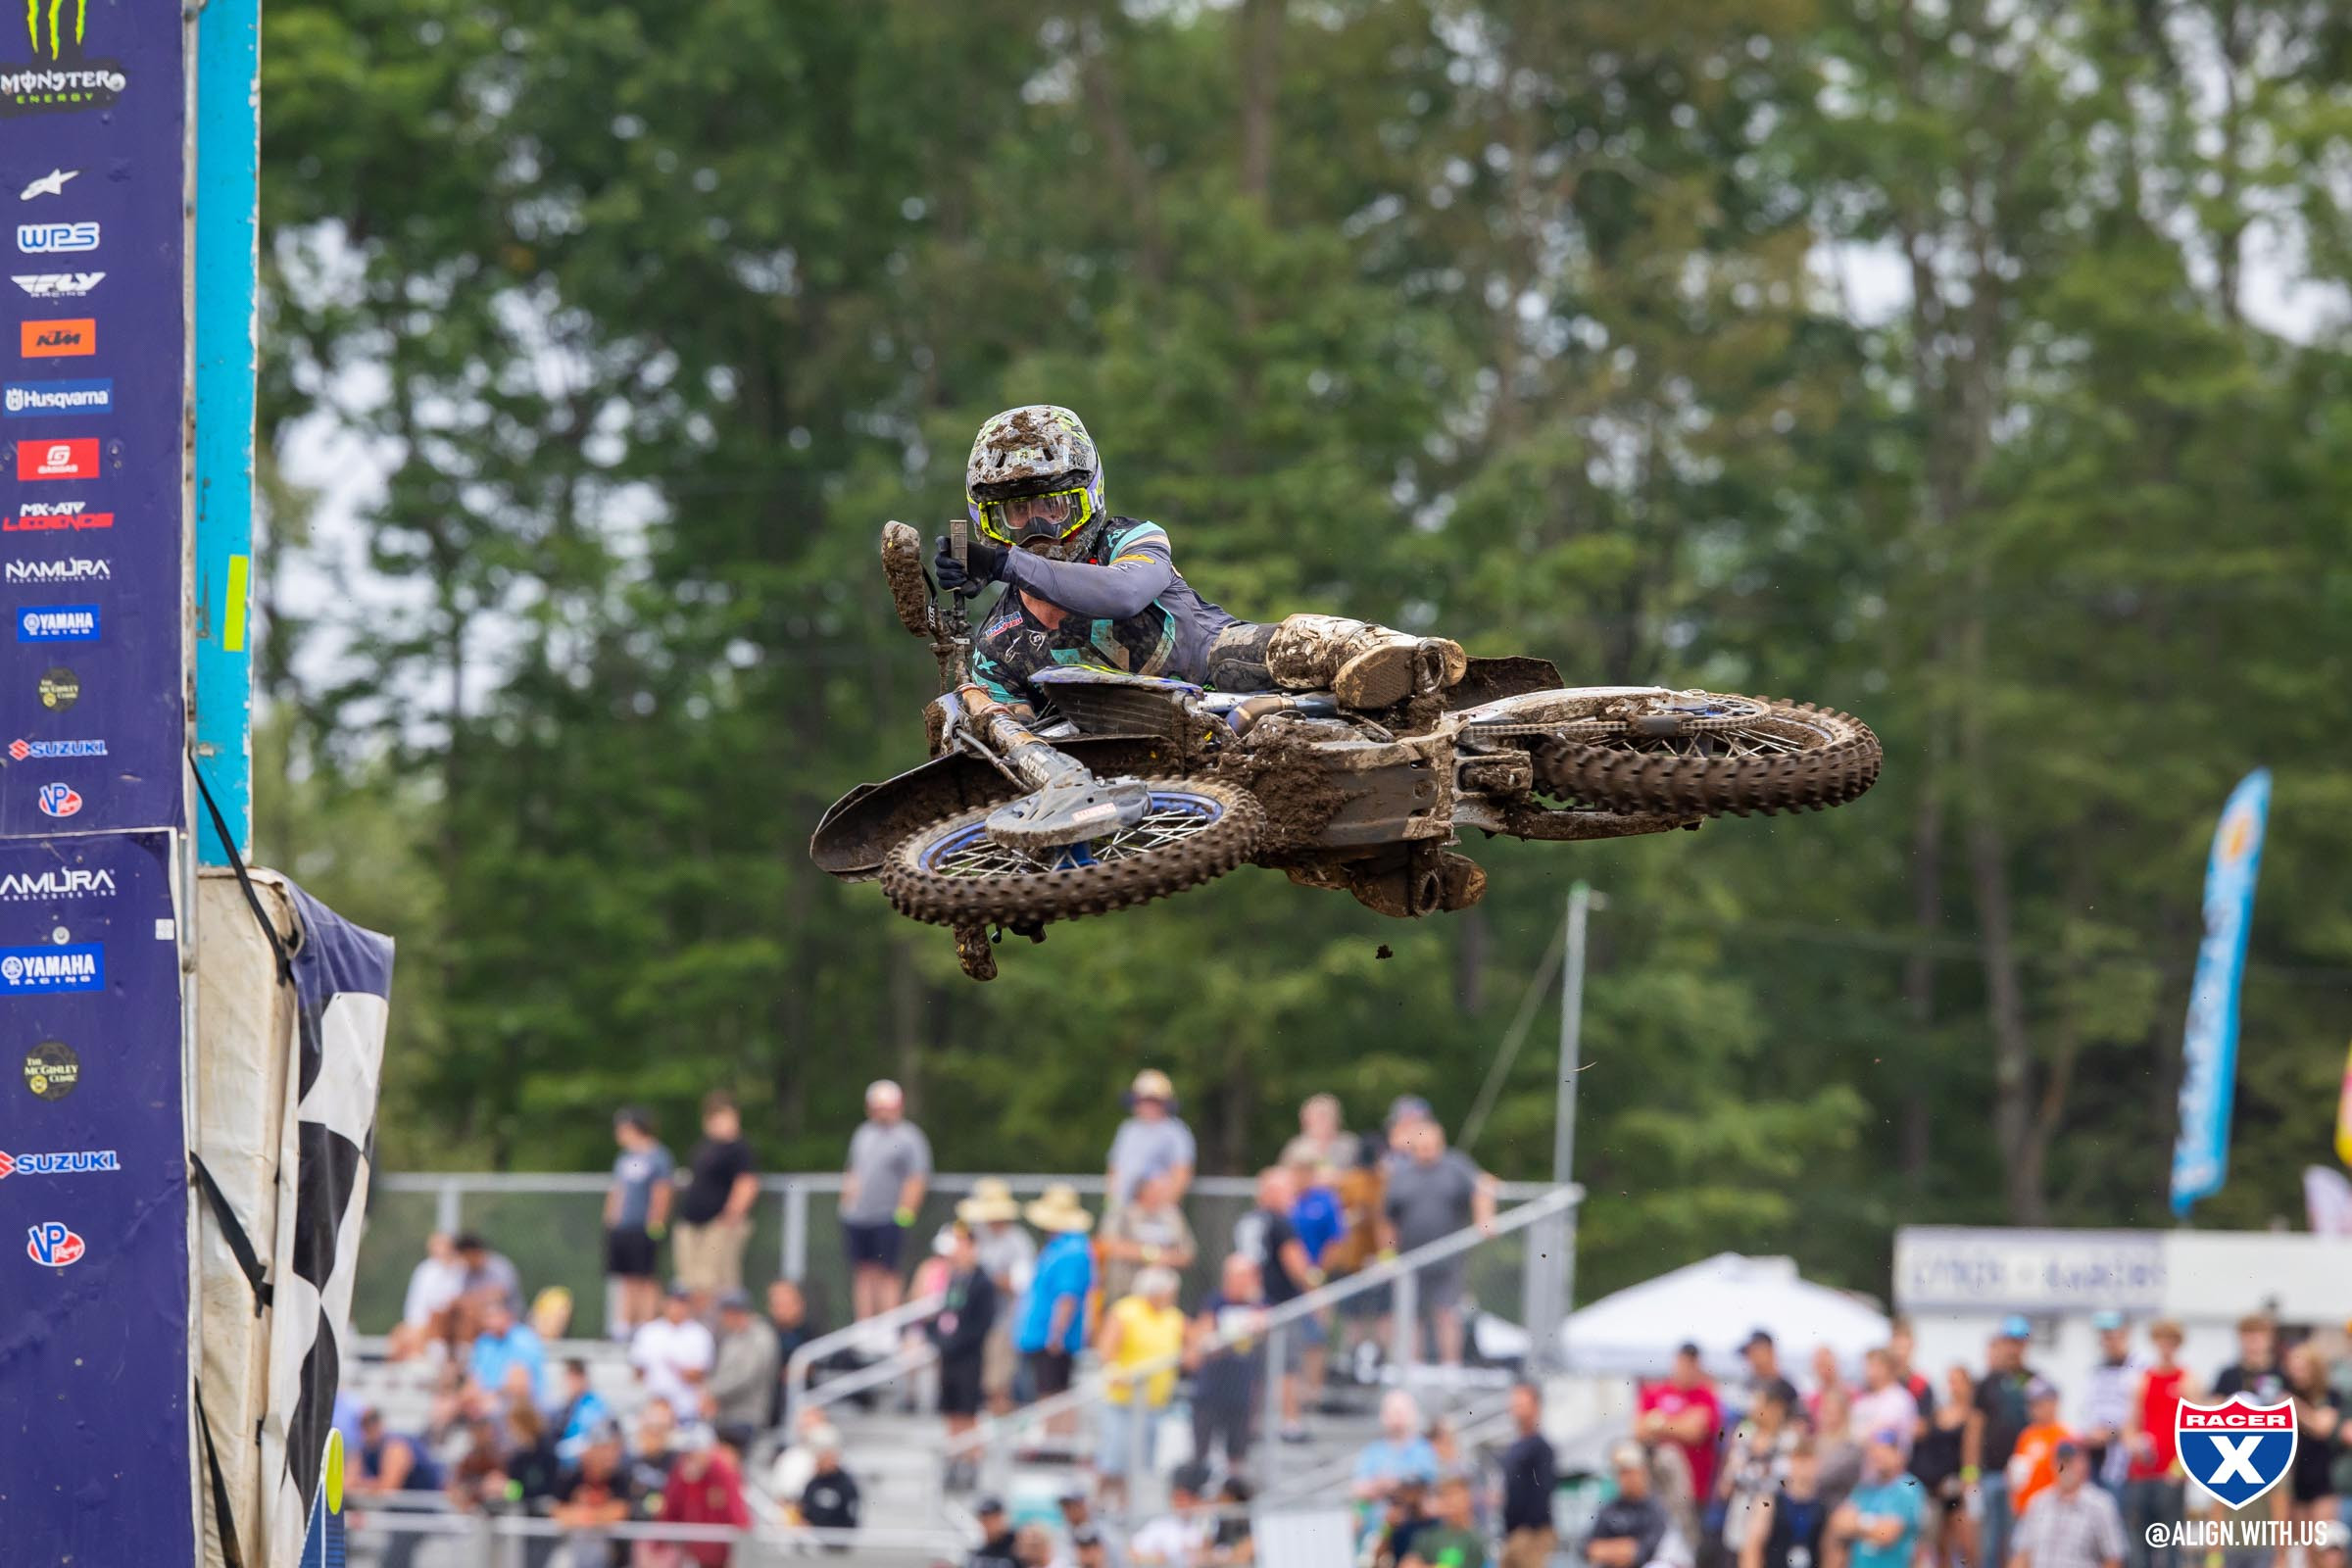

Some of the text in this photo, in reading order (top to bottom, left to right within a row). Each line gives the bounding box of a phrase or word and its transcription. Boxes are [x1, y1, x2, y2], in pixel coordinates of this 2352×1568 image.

[0, 69, 112, 94] MONSTER
[16, 92, 93, 104] ENERGY
[22, 225, 96, 248] WPS
[36, 330, 81, 346] KTM
[24, 389, 109, 409] Husqvarna
[5, 557, 111, 579] NAMURA
[39, 612, 94, 629] YAMAHA
[31, 741, 106, 757] SUZUKI
[43, 786, 69, 813] VP
[23, 954, 96, 977] YAMAHA
[9, 975, 91, 986] RACING
[17, 1152, 117, 1174] SUZUKI
[31, 1224, 66, 1264] VP
